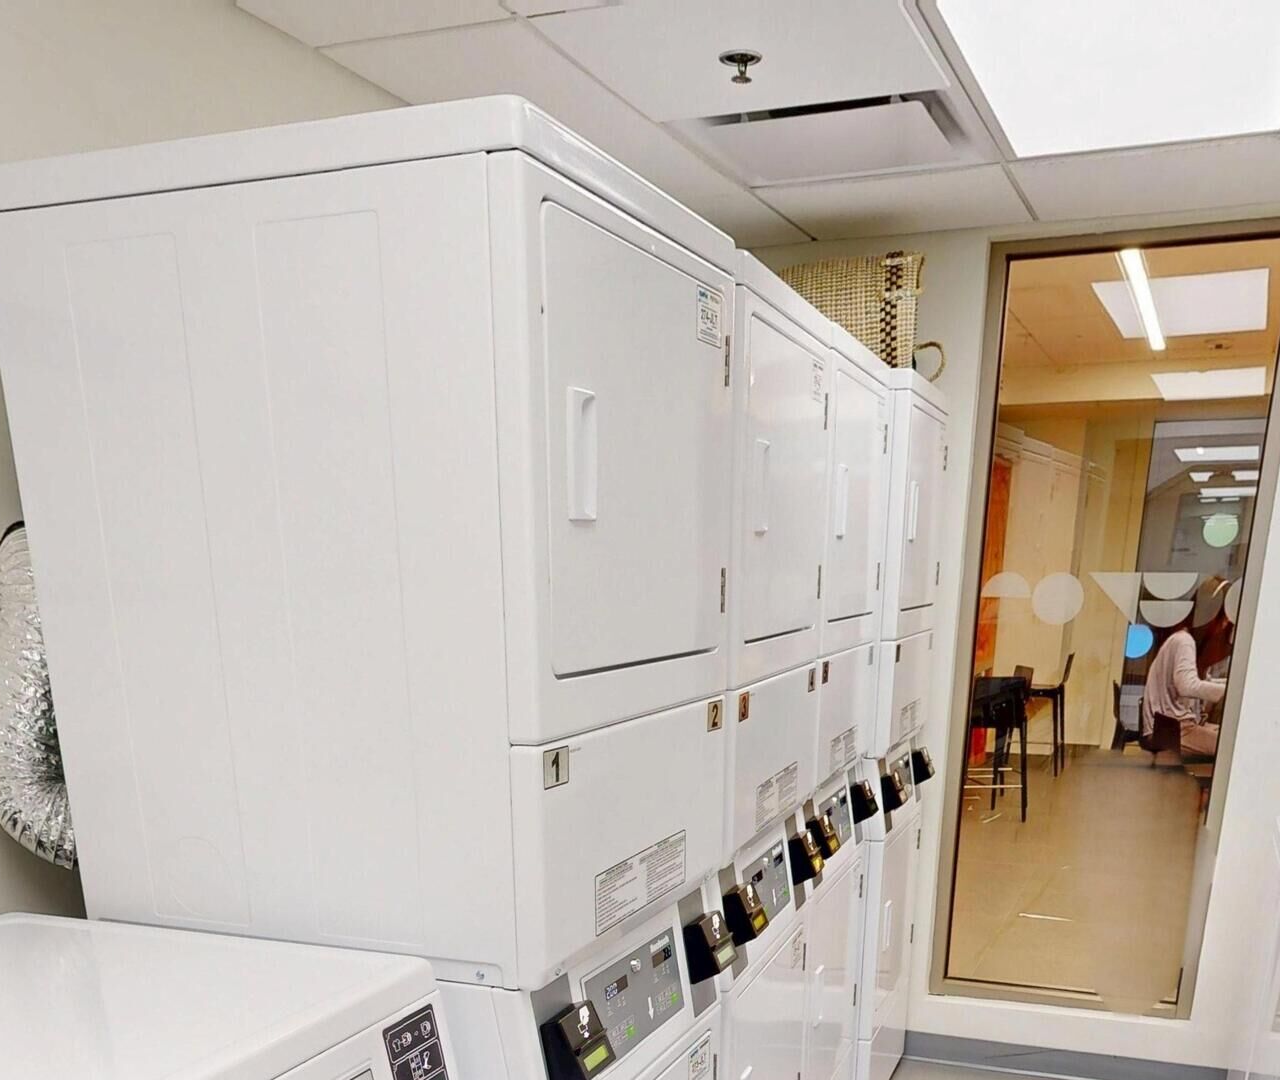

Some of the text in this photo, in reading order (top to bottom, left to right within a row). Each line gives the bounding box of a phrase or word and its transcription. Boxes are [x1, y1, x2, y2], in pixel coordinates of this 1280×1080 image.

[711, 703, 719, 728] 2
[741, 695, 748, 719] 3
[551, 751, 560, 782] 1
